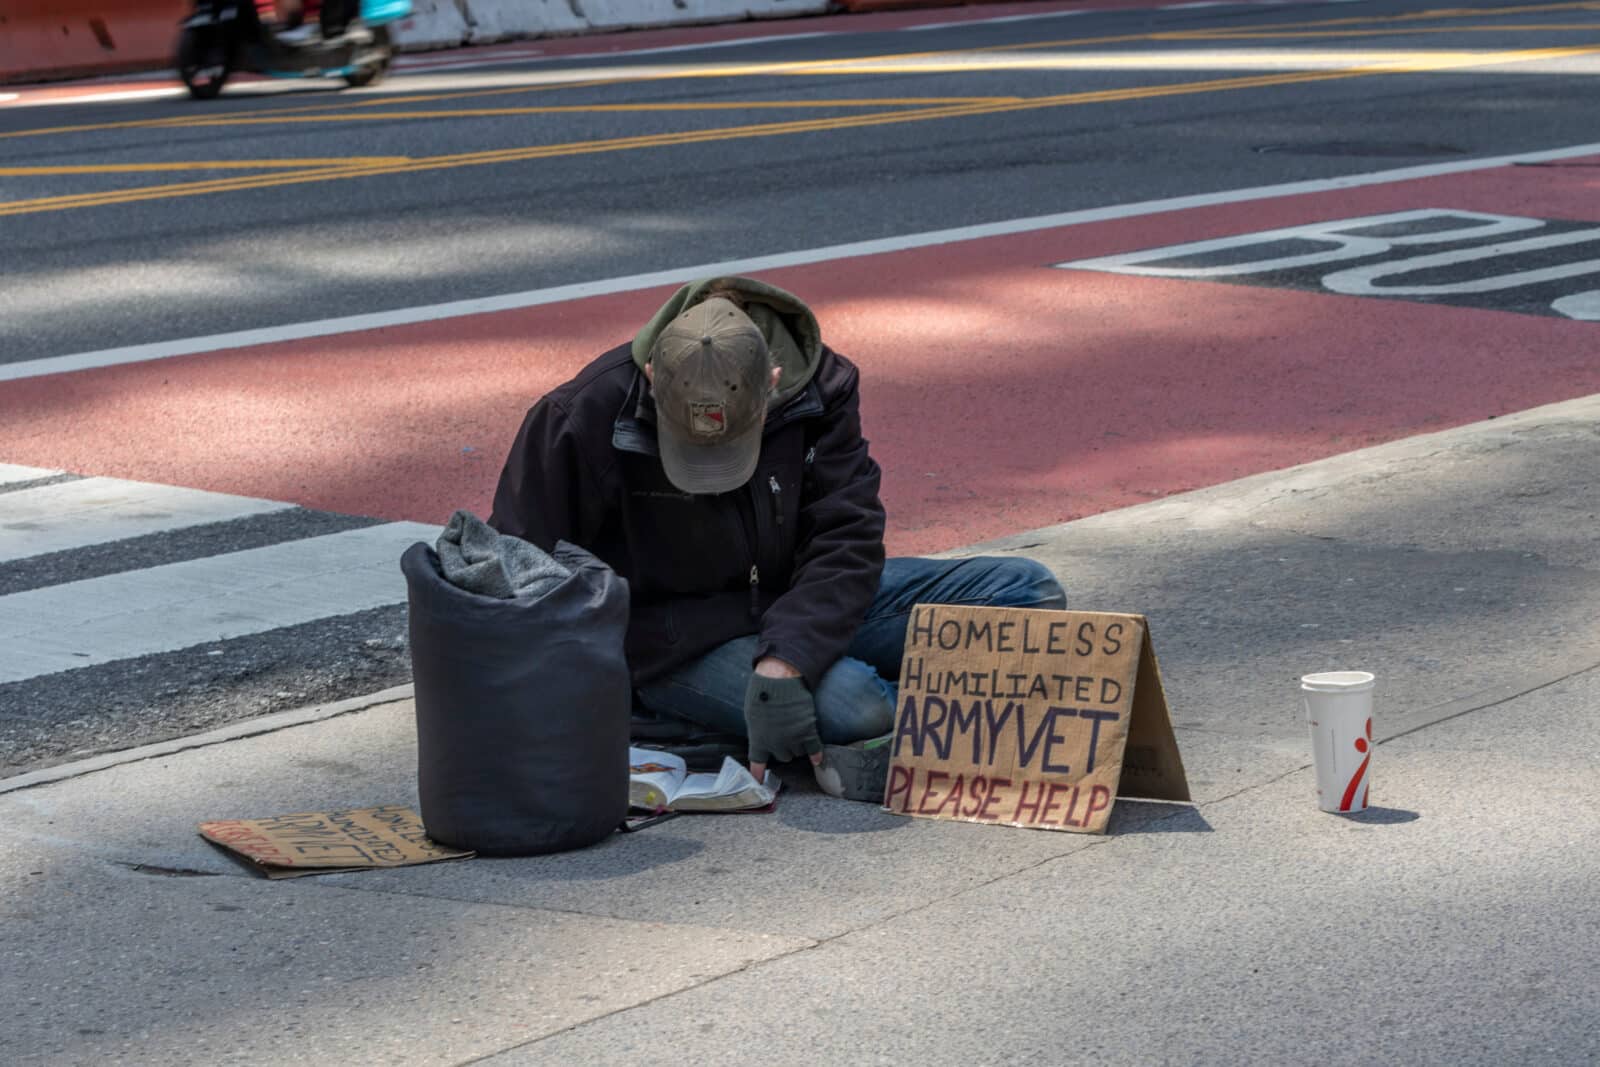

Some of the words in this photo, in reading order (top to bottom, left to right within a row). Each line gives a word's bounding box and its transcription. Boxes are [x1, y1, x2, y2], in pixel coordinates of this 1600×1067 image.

[1054, 207, 1600, 321] BU
[911, 607, 1123, 656] HOMELESS
[904, 657, 1121, 704] HUMILIATED
[886, 765, 1012, 819] PLEASE
[1011, 781, 1112, 827] HELP
